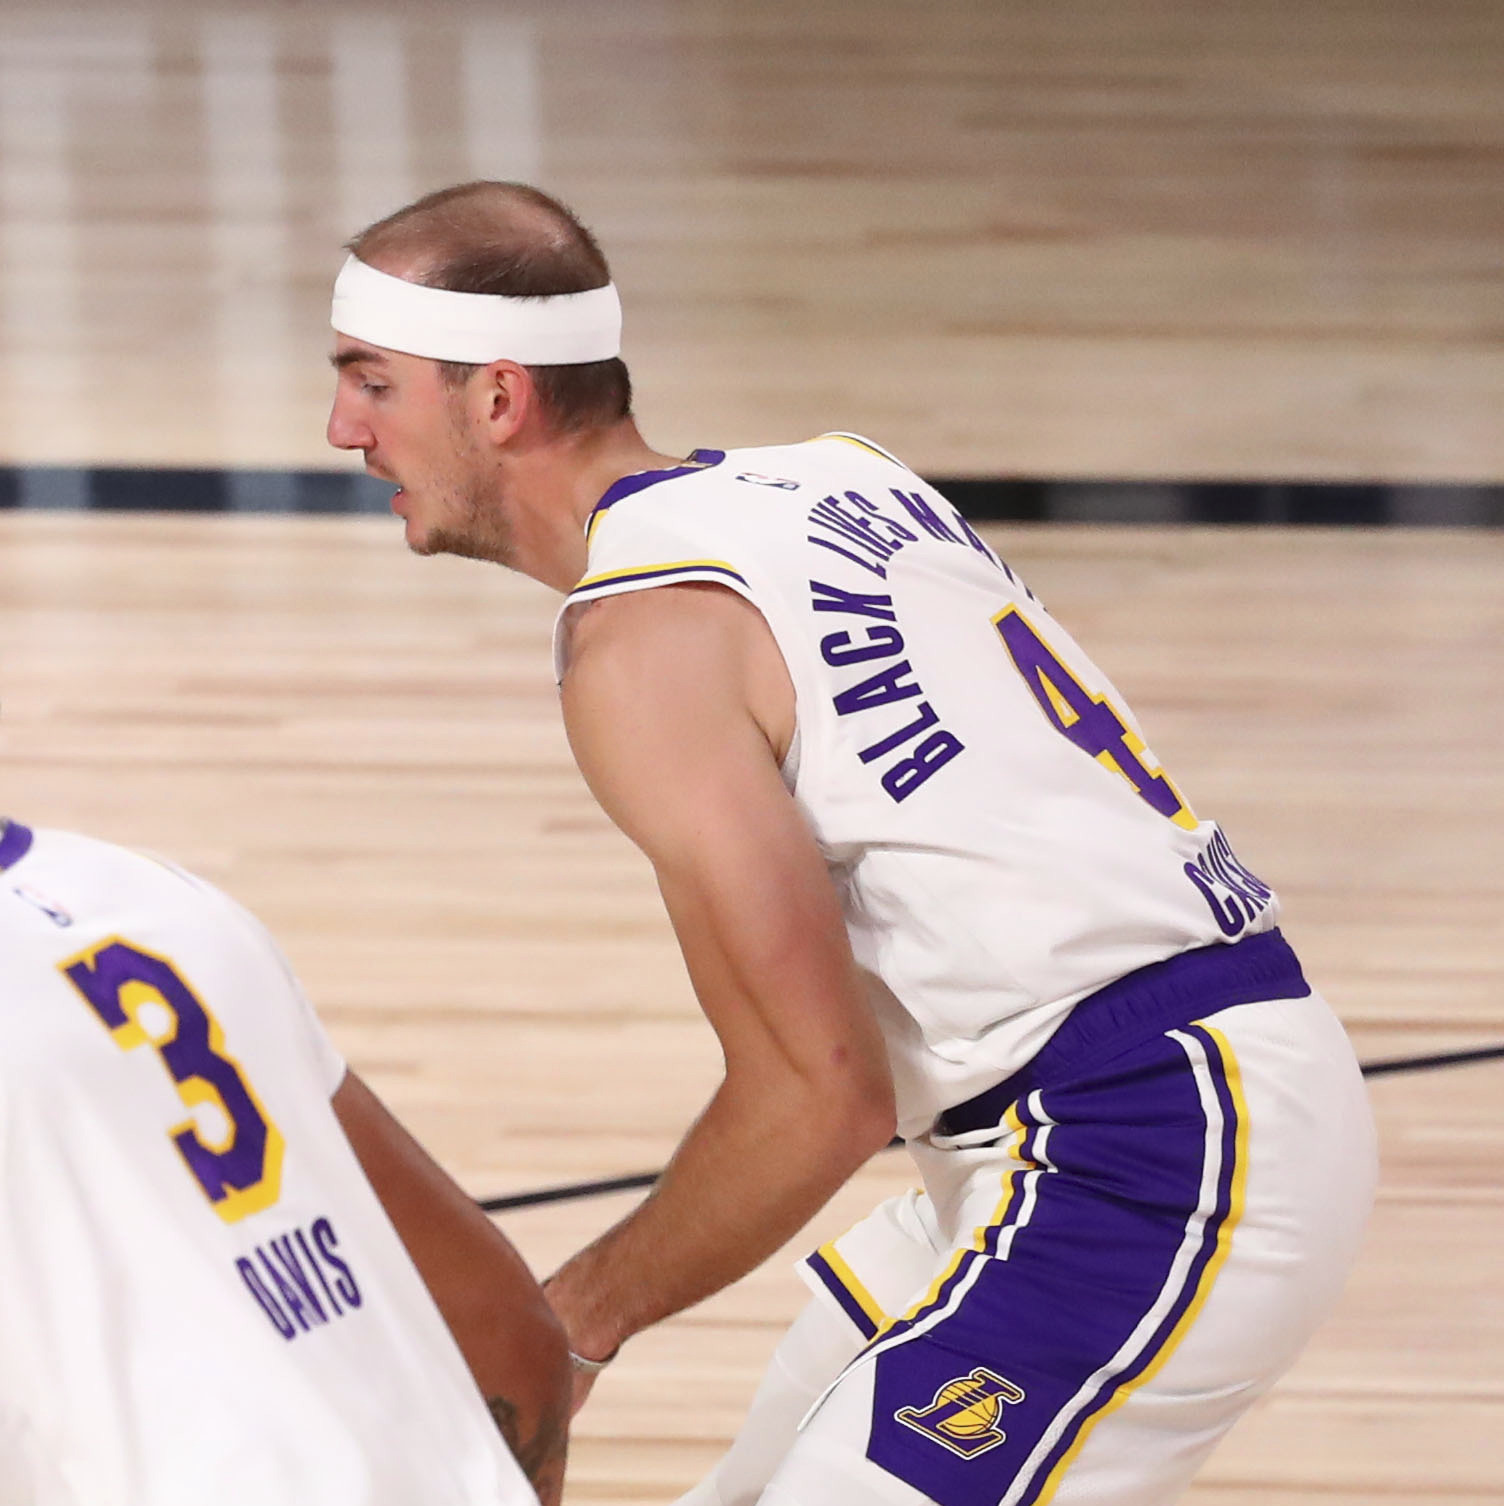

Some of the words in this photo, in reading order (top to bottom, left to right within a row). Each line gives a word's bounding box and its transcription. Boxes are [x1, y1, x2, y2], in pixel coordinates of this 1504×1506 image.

[807, 490, 919, 580] LIVES
[809, 579, 966, 804] BLACK
[989, 602, 1199, 831] 4
[56, 933, 286, 1226] 3
[235, 1216, 363, 1342] DAVIS
